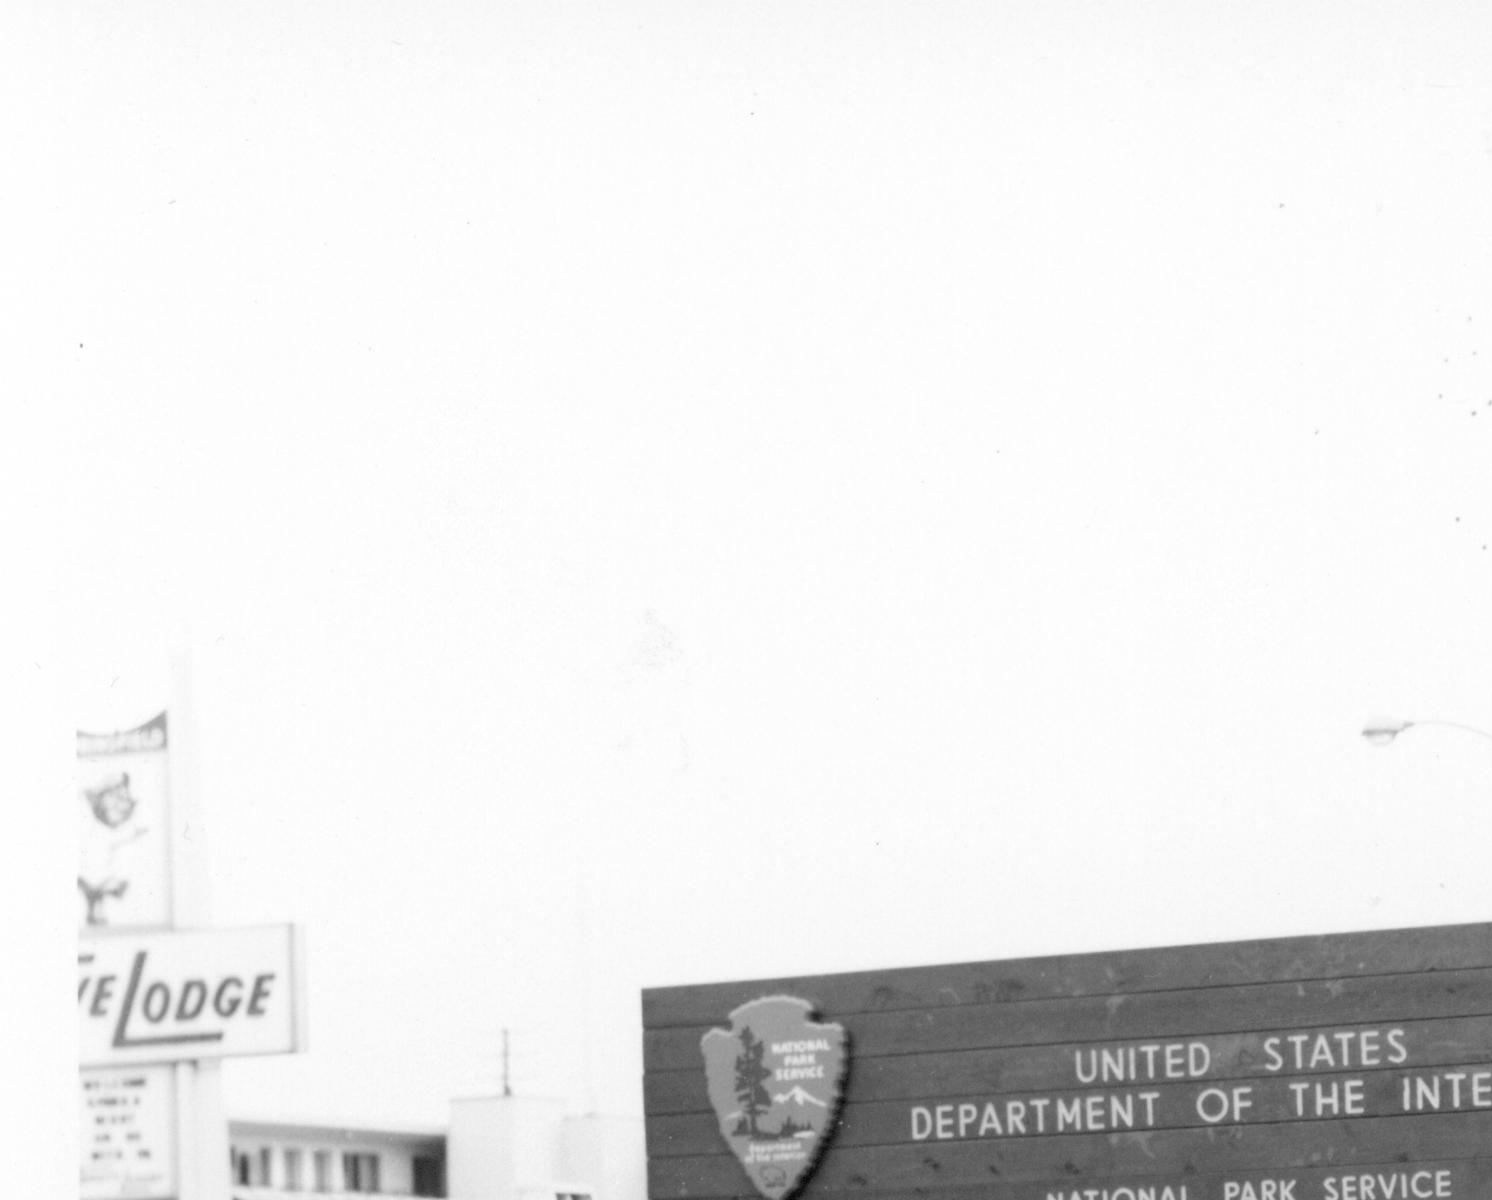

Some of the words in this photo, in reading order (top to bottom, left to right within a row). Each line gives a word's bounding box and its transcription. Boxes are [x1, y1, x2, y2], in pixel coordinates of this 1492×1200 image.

[772, 1039, 830, 1053] NATIONAL
[784, 1054, 815, 1066] PARK
[1076, 1042, 1210, 1082] UNITED
[1264, 1029, 1407, 1070] STATES
[775, 1065, 824, 1081] SERVICE
[911, 1092, 1159, 1139] DEPARTMENT
[1196, 1087, 1251, 1122] OF
[1289, 1080, 1364, 1115] THE
